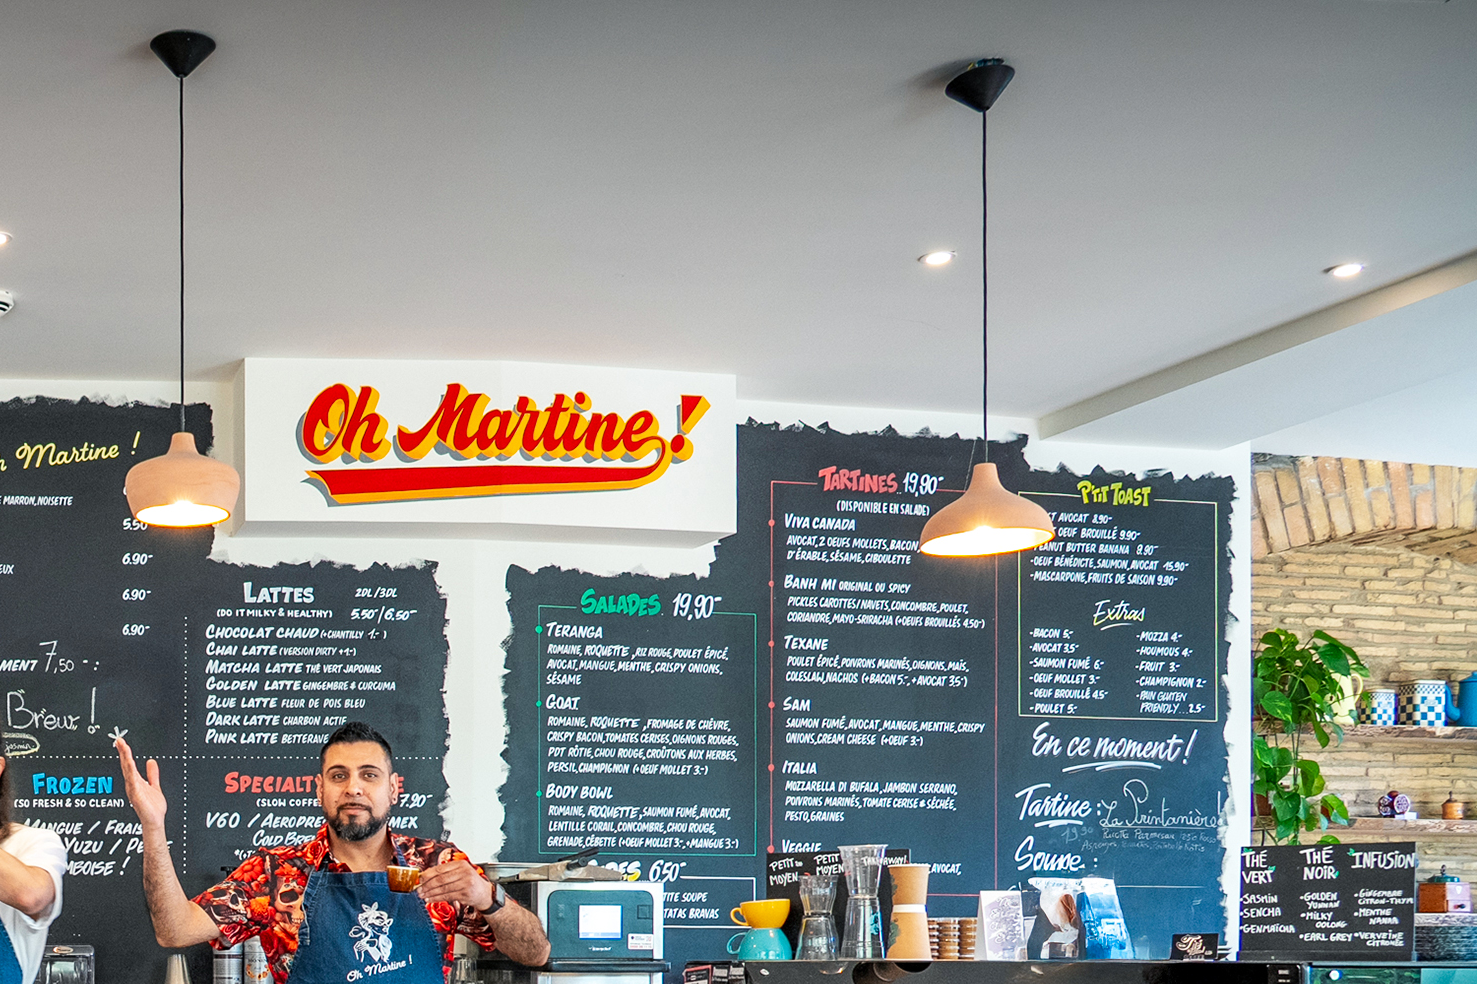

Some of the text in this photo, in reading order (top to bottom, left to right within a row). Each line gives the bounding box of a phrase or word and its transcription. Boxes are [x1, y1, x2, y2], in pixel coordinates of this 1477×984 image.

[296, 382, 711, 464] Oh Martine !
[16, 442, 119, 469] Martine
[819, 466, 898, 493] TARTINES
[1110, 482, 1151, 506] TOAST
[837, 500, 929, 516] (DISPONIBLE EN SALADE)
[785, 513, 855, 530] VIVA CANADA
[1066, 543, 1129, 554] BUTTER BANANA
[784, 574, 911, 593] BANH MI ORIGINAL OU SPICY
[243, 582, 314, 603] LATTES
[355, 587, 397, 598] 2DL/3DL
[581, 588, 662, 616] SALADES
[247, 609, 332, 618] MILKY HEALTHY)
[206, 624, 319, 639] CHOCOLAT CHAUD
[546, 622, 602, 638] TERANGA
[206, 642, 277, 655] CHAI LATTE
[784, 635, 828, 650] TEXANE
[205, 660, 381, 673] MATCHA LATTE THÉ VERT JAPONAIS
[206, 676, 301, 690] GOLDEN LATTE
[546, 674, 581, 685] SÉSAME
[206, 695, 365, 708] BLUE LATTE FLEUR DE POIS BLEU
[783, 697, 810, 711] SAM
[206, 712, 320, 726] DARK LATTE CHARBON
[205, 729, 278, 744] PINK LATTE
[1031, 721, 1062, 758] En
[1066, 737, 1090, 756] ce
[1093, 730, 1184, 762] moment
[782, 760, 817, 774] ITALIA
[33, 773, 112, 794] FROZEN
[546, 783, 613, 799] BODY BOWL
[785, 781, 835, 791] MOZZARELLA
[33, 799, 63, 807] FRESH
[1014, 782, 1092, 821] Tartine
[206, 812, 240, 828] V60
[549, 821, 585, 831] LENTILLE
[1242, 852, 1267, 869] THÉ
[1241, 870, 1273, 885] VERT
[681, 892, 708, 902] SOUPE
[689, 908, 719, 918] BRAVAS
[1330, 933, 1352, 941] GREY
[346, 961, 406, 982] Oh Martine
